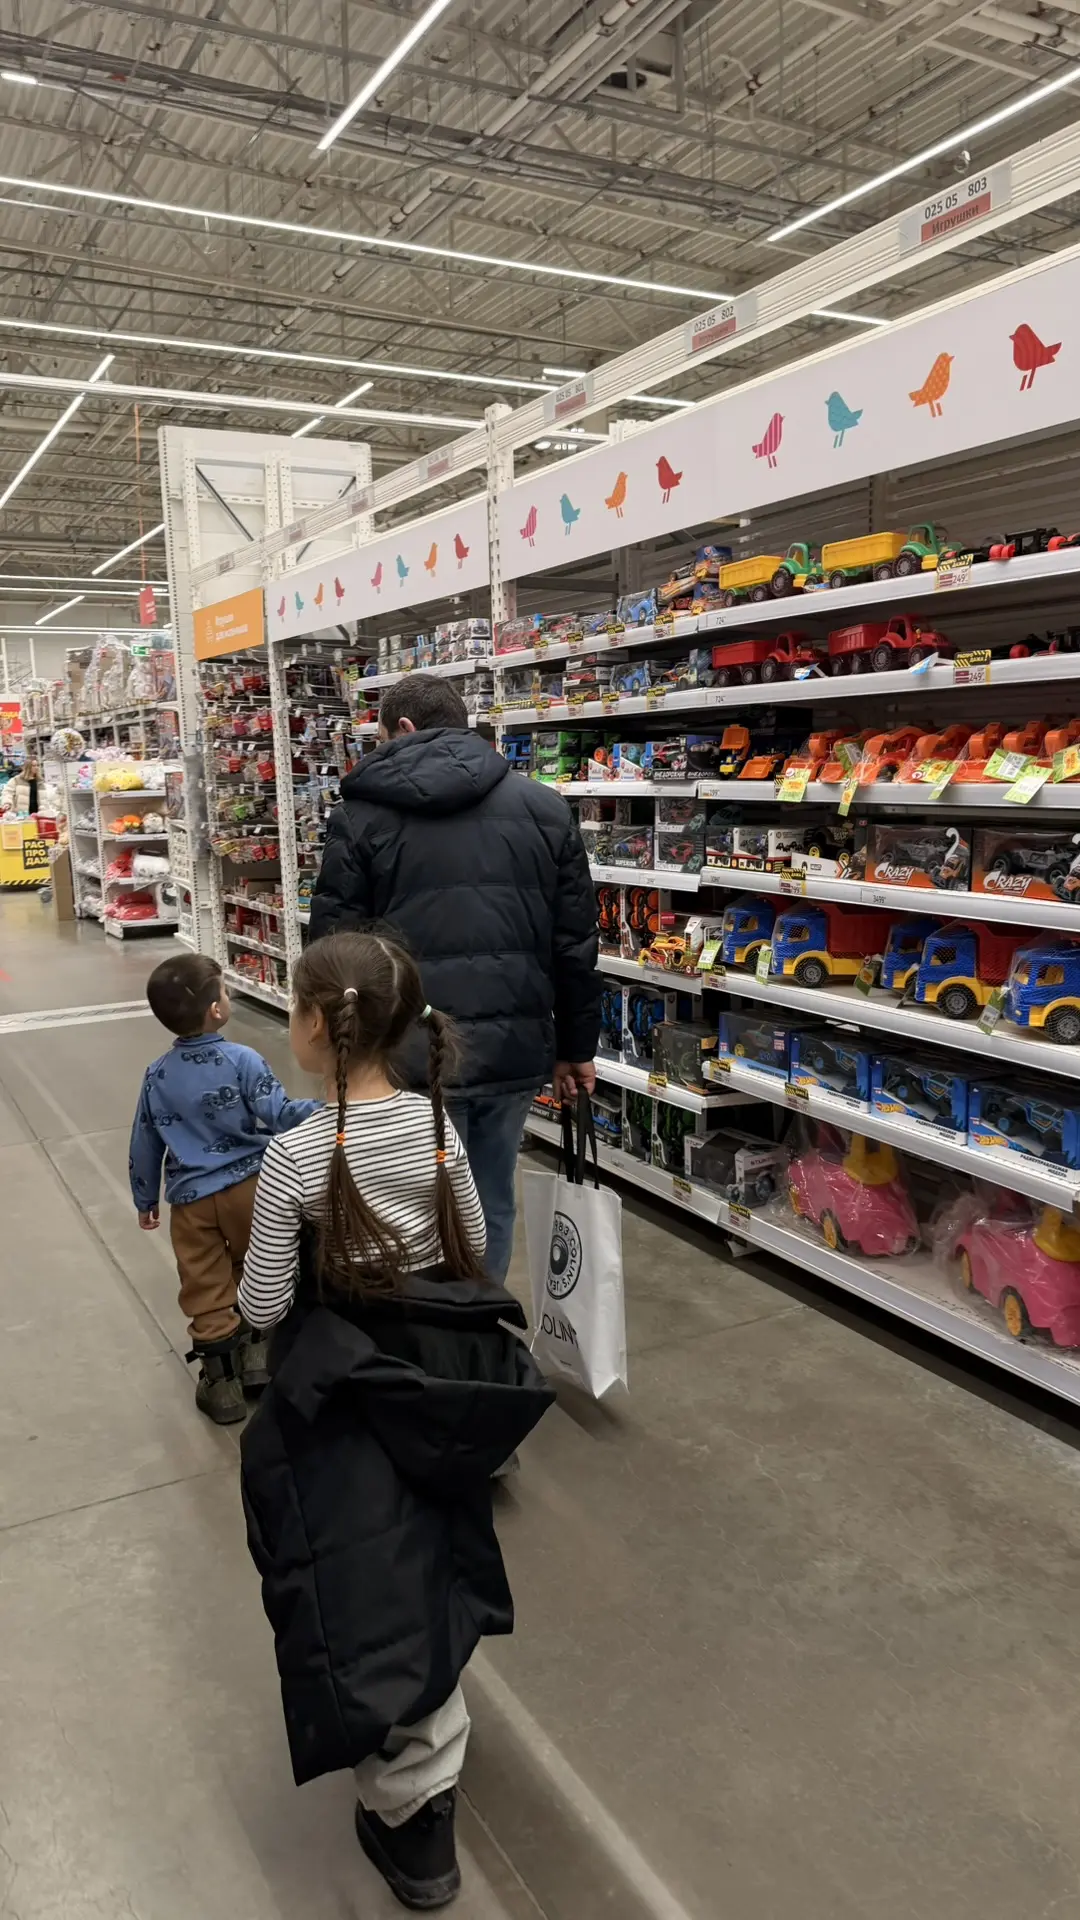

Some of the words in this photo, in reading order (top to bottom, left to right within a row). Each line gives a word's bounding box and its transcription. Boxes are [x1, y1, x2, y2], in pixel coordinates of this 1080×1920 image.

[924, 201, 943, 219] 025
[945, 193, 958, 209] 05
[967, 177, 987, 197] 803
[932, 205, 979, 235] Игрушки
[693, 319, 706, 333] 025
[707, 315, 716, 327] 05
[721, 306, 734, 320] 802
[24, 840, 45, 849] РАС
[25, 849, 46, 858] ПРО
[26, 857, 50, 866] ДАЖ
[874, 862, 914, 885] CRAZY
[983, 871, 1033, 896] CRAZY
[562, 1238, 577, 1288] COLIN'S
